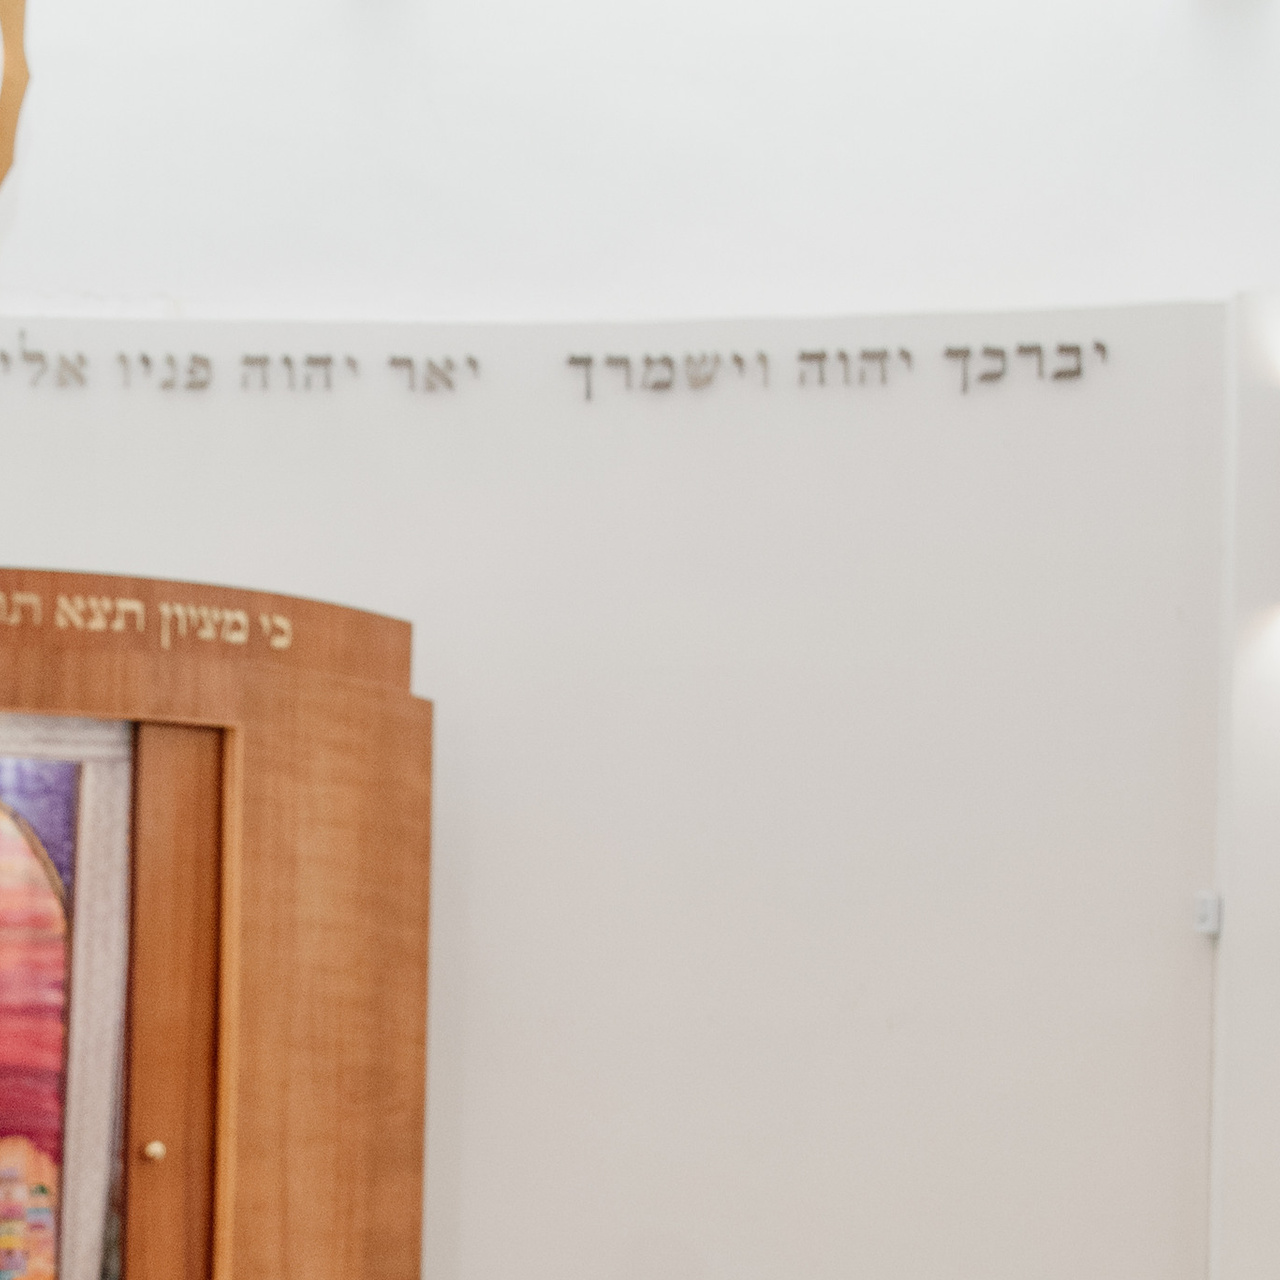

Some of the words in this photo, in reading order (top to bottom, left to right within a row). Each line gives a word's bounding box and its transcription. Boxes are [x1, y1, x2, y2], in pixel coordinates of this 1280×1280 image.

[116, 352, 214, 395] פניו
[240, 353, 360, 392] יהוה
[386, 354, 482, 396] יאר
[564, 351, 770, 403] וישמרך
[796, 347, 915, 389] יהוה
[942, 340, 1110, 396] יברכך
[54, 595, 146, 633] תצא
[158, 601, 250, 650] מציון
[258, 612, 294, 650] כי
